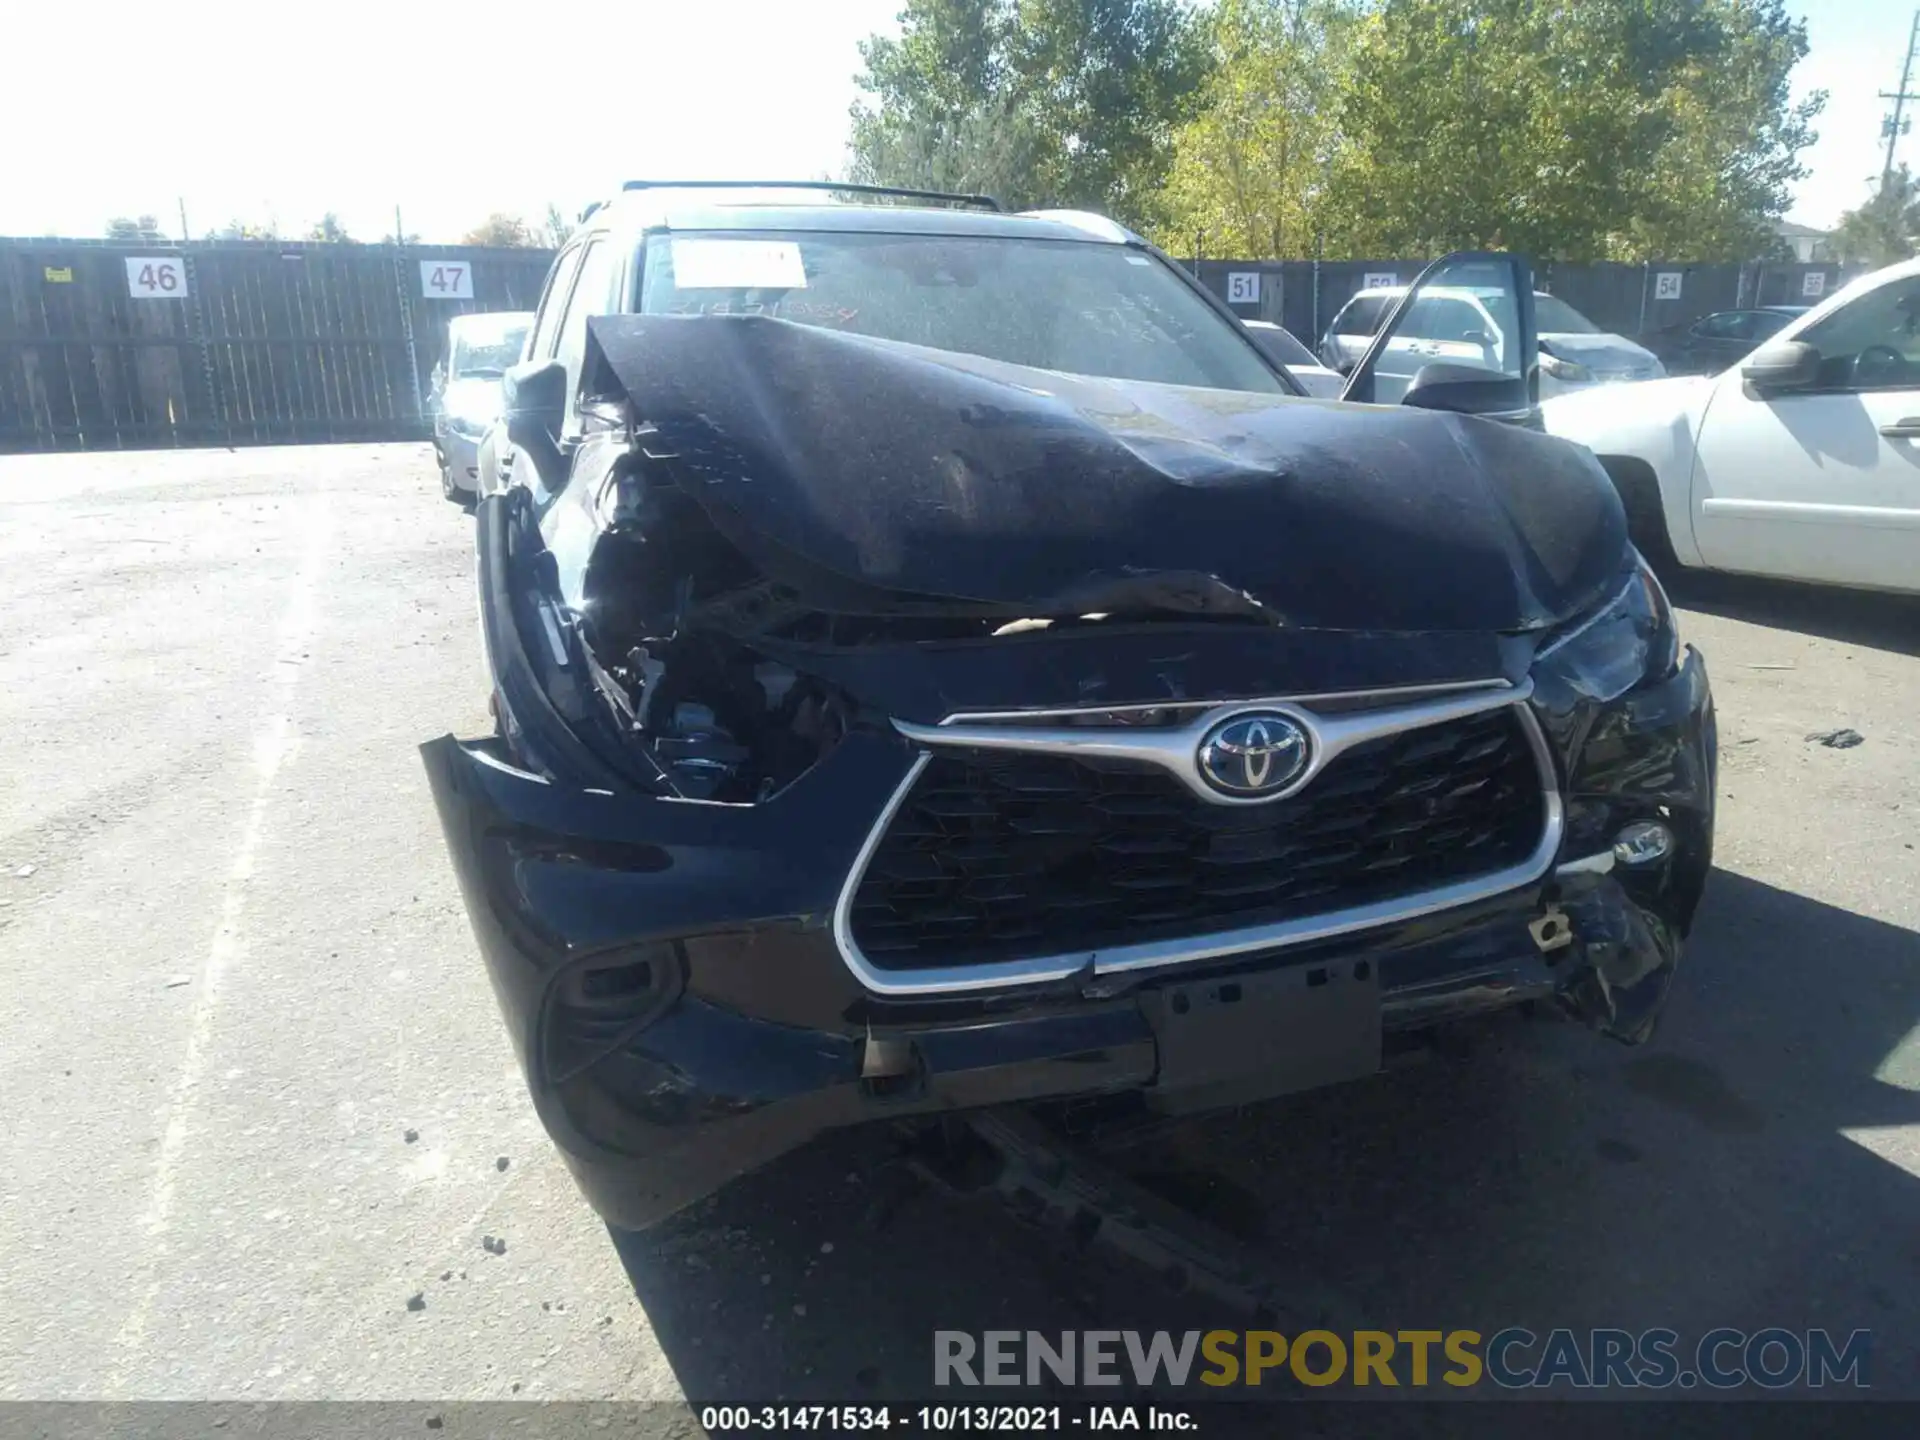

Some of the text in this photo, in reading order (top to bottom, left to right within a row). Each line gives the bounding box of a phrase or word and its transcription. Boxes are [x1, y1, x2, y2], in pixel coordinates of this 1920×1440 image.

[138, 264, 178, 292] 46
[430, 266, 464, 292] 47
[1234, 277, 1253, 298] 51
[1659, 277, 1678, 295] 54
